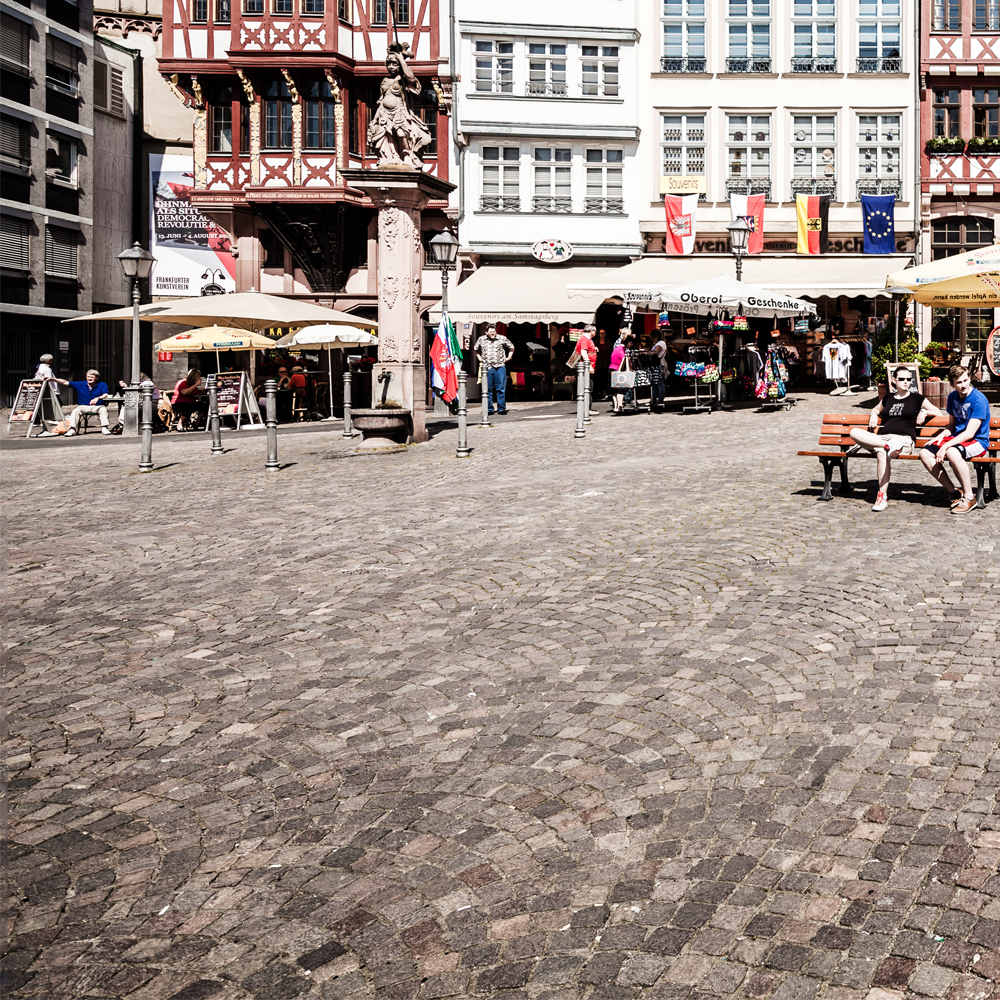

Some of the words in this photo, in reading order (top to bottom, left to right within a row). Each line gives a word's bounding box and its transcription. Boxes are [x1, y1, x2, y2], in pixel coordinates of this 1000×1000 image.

[668, 177, 699, 190] Souvenirs
[156, 200, 193, 208] OHNM
[156, 207, 177, 215] ALS
[157, 221, 208, 229] REVOLUTIE
[155, 276, 190, 284] FRANKFURTER
[680, 292, 723, 304] Oberoi
[747, 296, 800, 310] Geschenke
[512, 312, 559, 321] Samstagsberg
